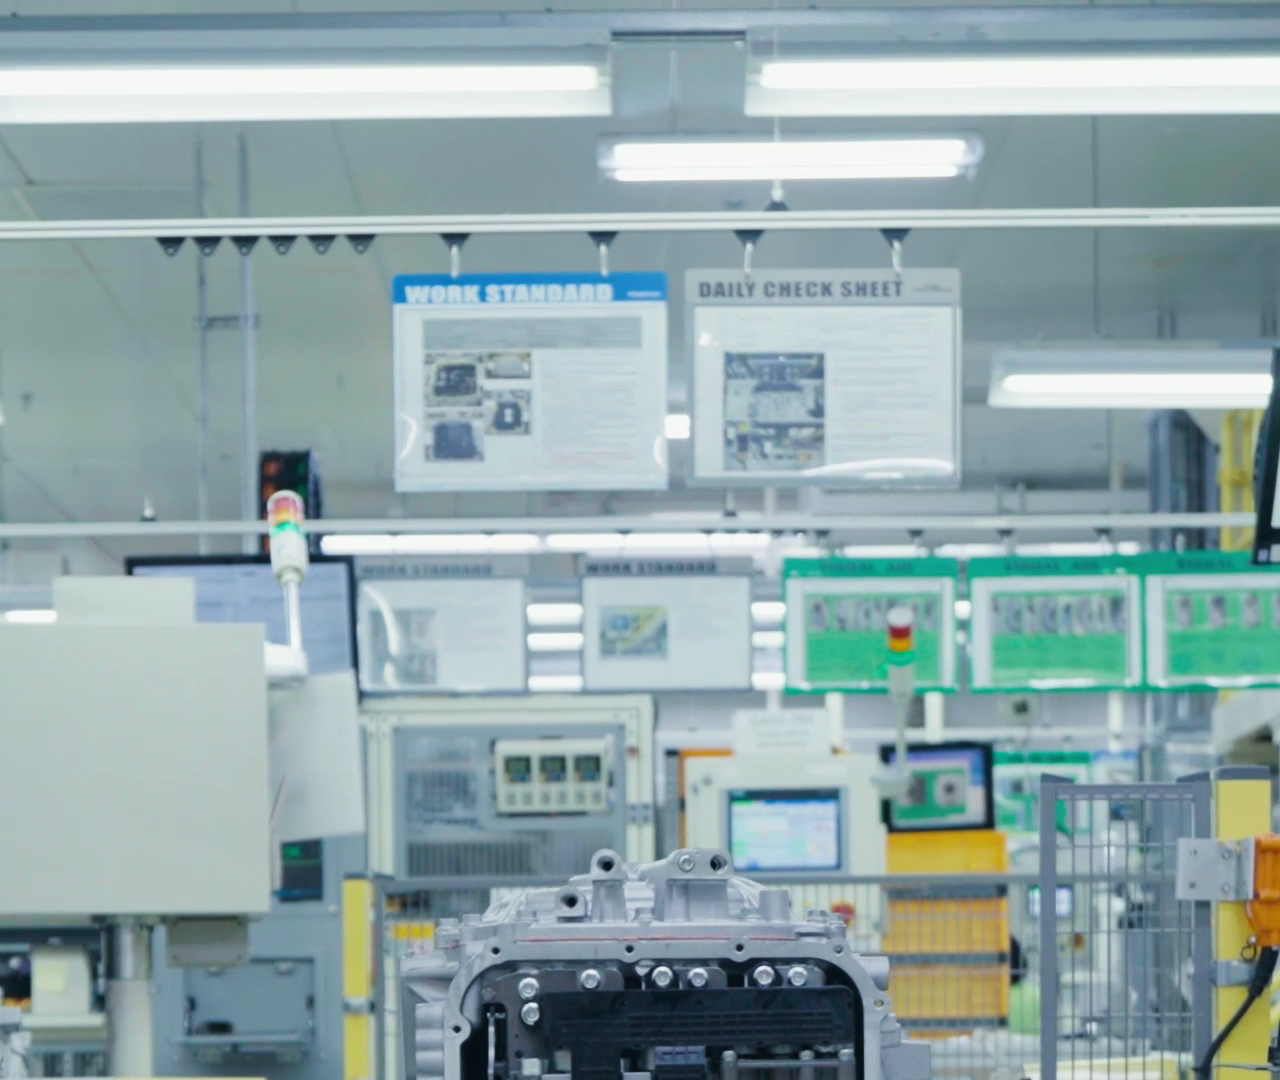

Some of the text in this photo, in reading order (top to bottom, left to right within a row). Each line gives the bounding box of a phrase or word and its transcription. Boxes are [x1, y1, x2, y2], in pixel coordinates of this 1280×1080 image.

[404, 284, 481, 302] WORK
[485, 283, 614, 302] STANDARD
[698, 281, 756, 298] DAILY
[763, 281, 834, 298] CHECK
[840, 280, 903, 297] SHEET
